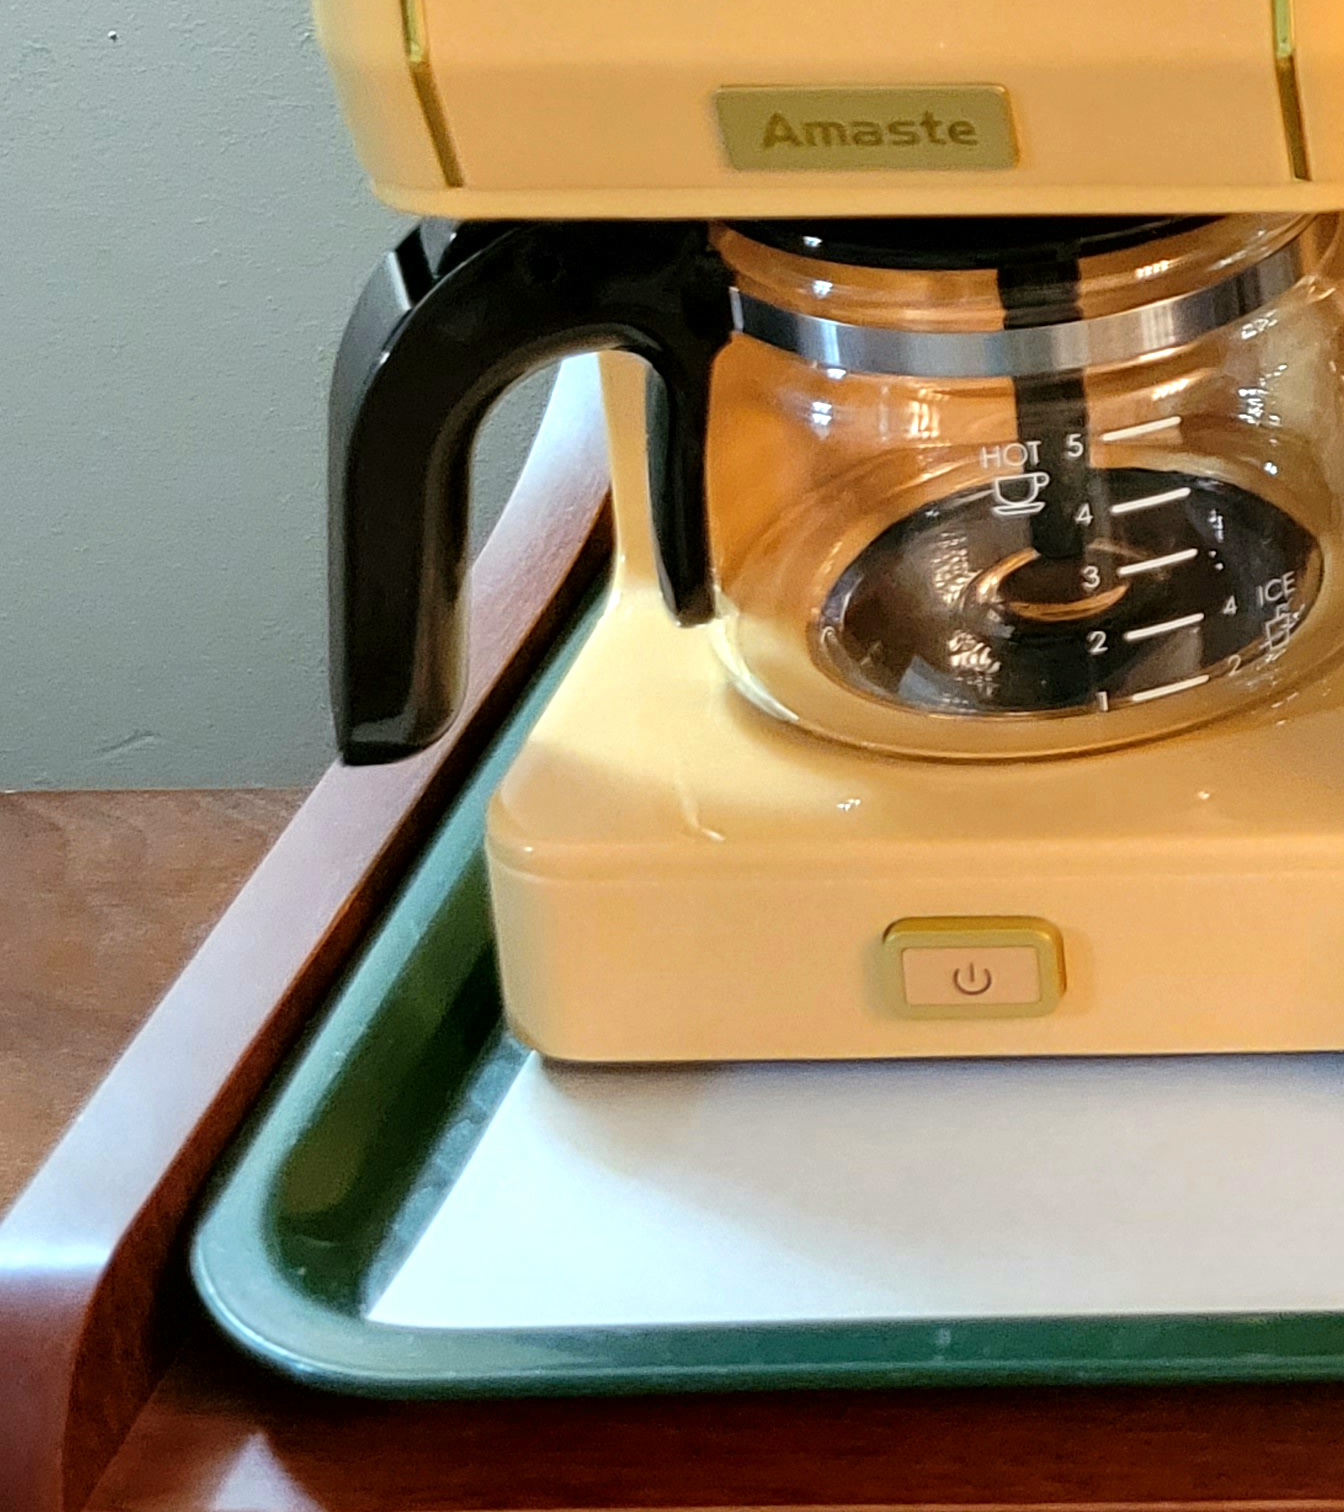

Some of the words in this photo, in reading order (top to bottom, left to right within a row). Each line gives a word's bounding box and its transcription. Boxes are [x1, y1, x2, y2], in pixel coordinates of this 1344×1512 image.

[761, 109, 978, 148] Amaste
[979, 440, 1041, 468] HOT
[1066, 433, 1084, 458] 5
[1075, 502, 1094, 526] 4
[1080, 565, 1100, 589] 3
[1257, 570, 1296, 607] ICE
[1222, 594, 1238, 616] 4
[1087, 630, 1109, 656] 2
[1227, 654, 1242, 677] 2
[1095, 690, 1110, 712] 1
